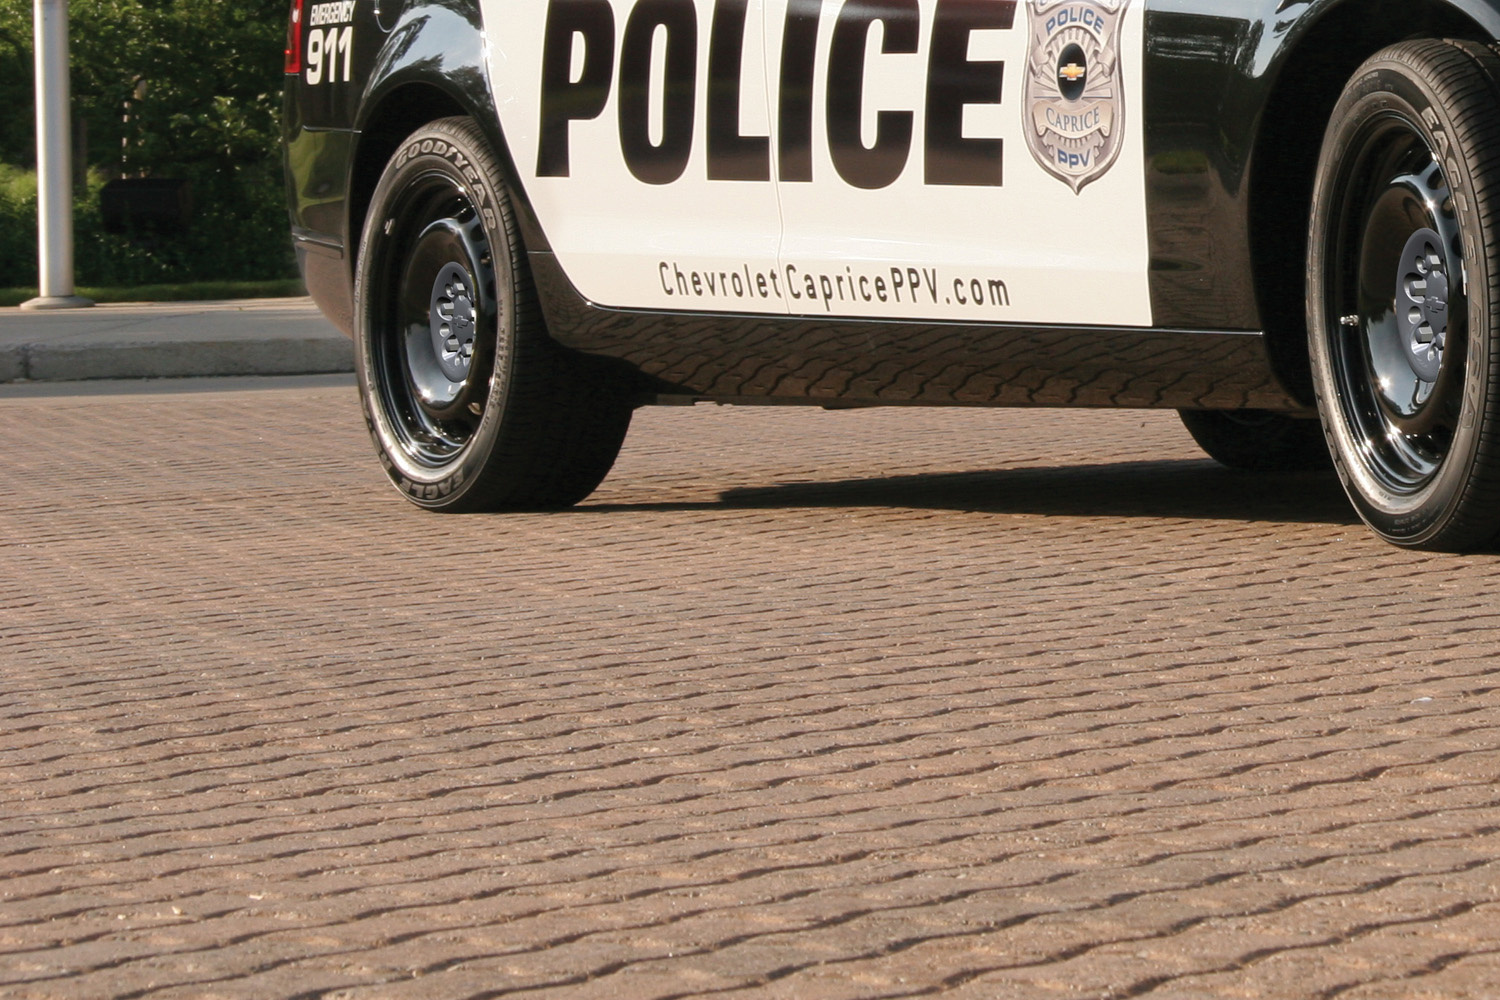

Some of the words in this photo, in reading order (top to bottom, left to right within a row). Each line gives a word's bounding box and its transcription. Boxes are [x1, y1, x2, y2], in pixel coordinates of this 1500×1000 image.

[310, 0, 356, 26] EMERGENCY
[1046, 7, 1104, 35] POLICE
[306, 26, 353, 85] 911
[1045, 106, 1100, 132] CAPRICE
[395, 139, 497, 230] GOODYEAR
[1421, 106, 1477, 266] EAGLE
[659, 262, 1010, 311] ChevroletCapricePPV.com
